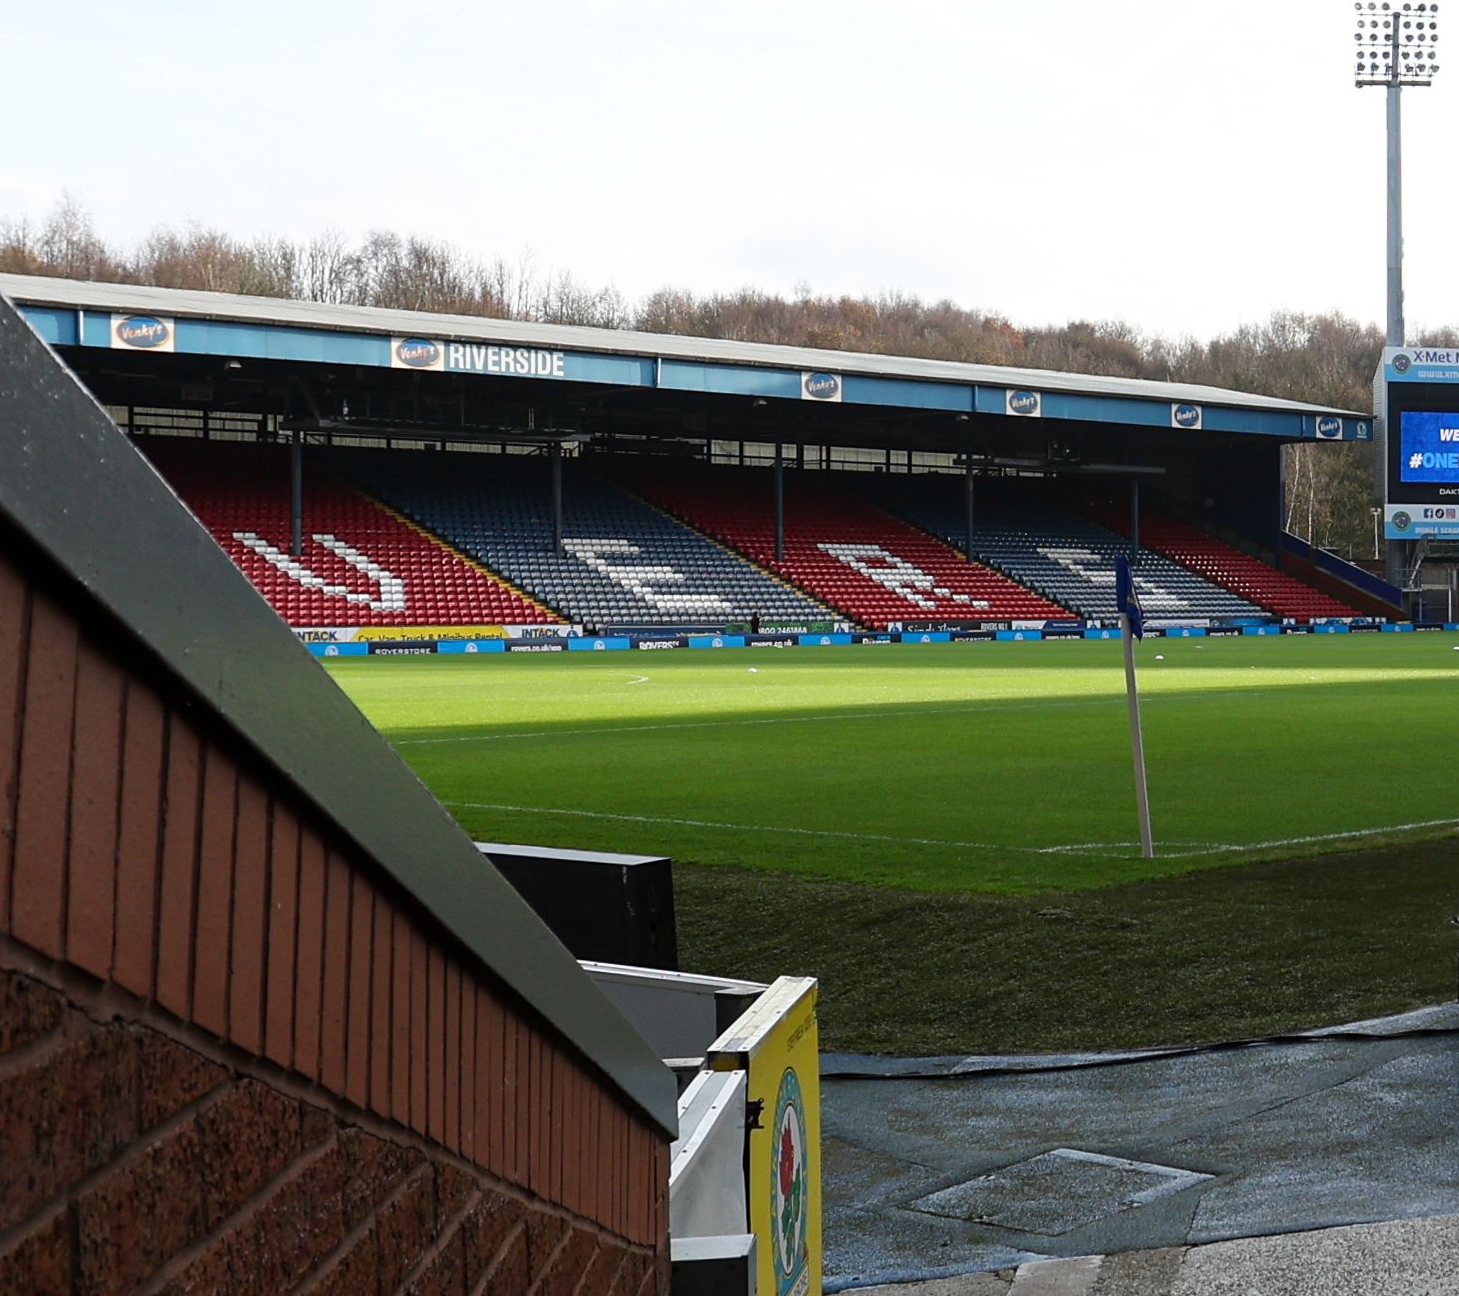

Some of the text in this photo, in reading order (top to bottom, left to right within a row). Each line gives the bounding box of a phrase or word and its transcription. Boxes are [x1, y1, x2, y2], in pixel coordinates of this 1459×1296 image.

[121, 323, 162, 341] Venky's
[400, 345, 434, 360] Venky's
[448, 342, 565, 377] RIVERSIDE
[297, 630, 338, 641] NTACK
[521, 628, 560, 638] INTACK
